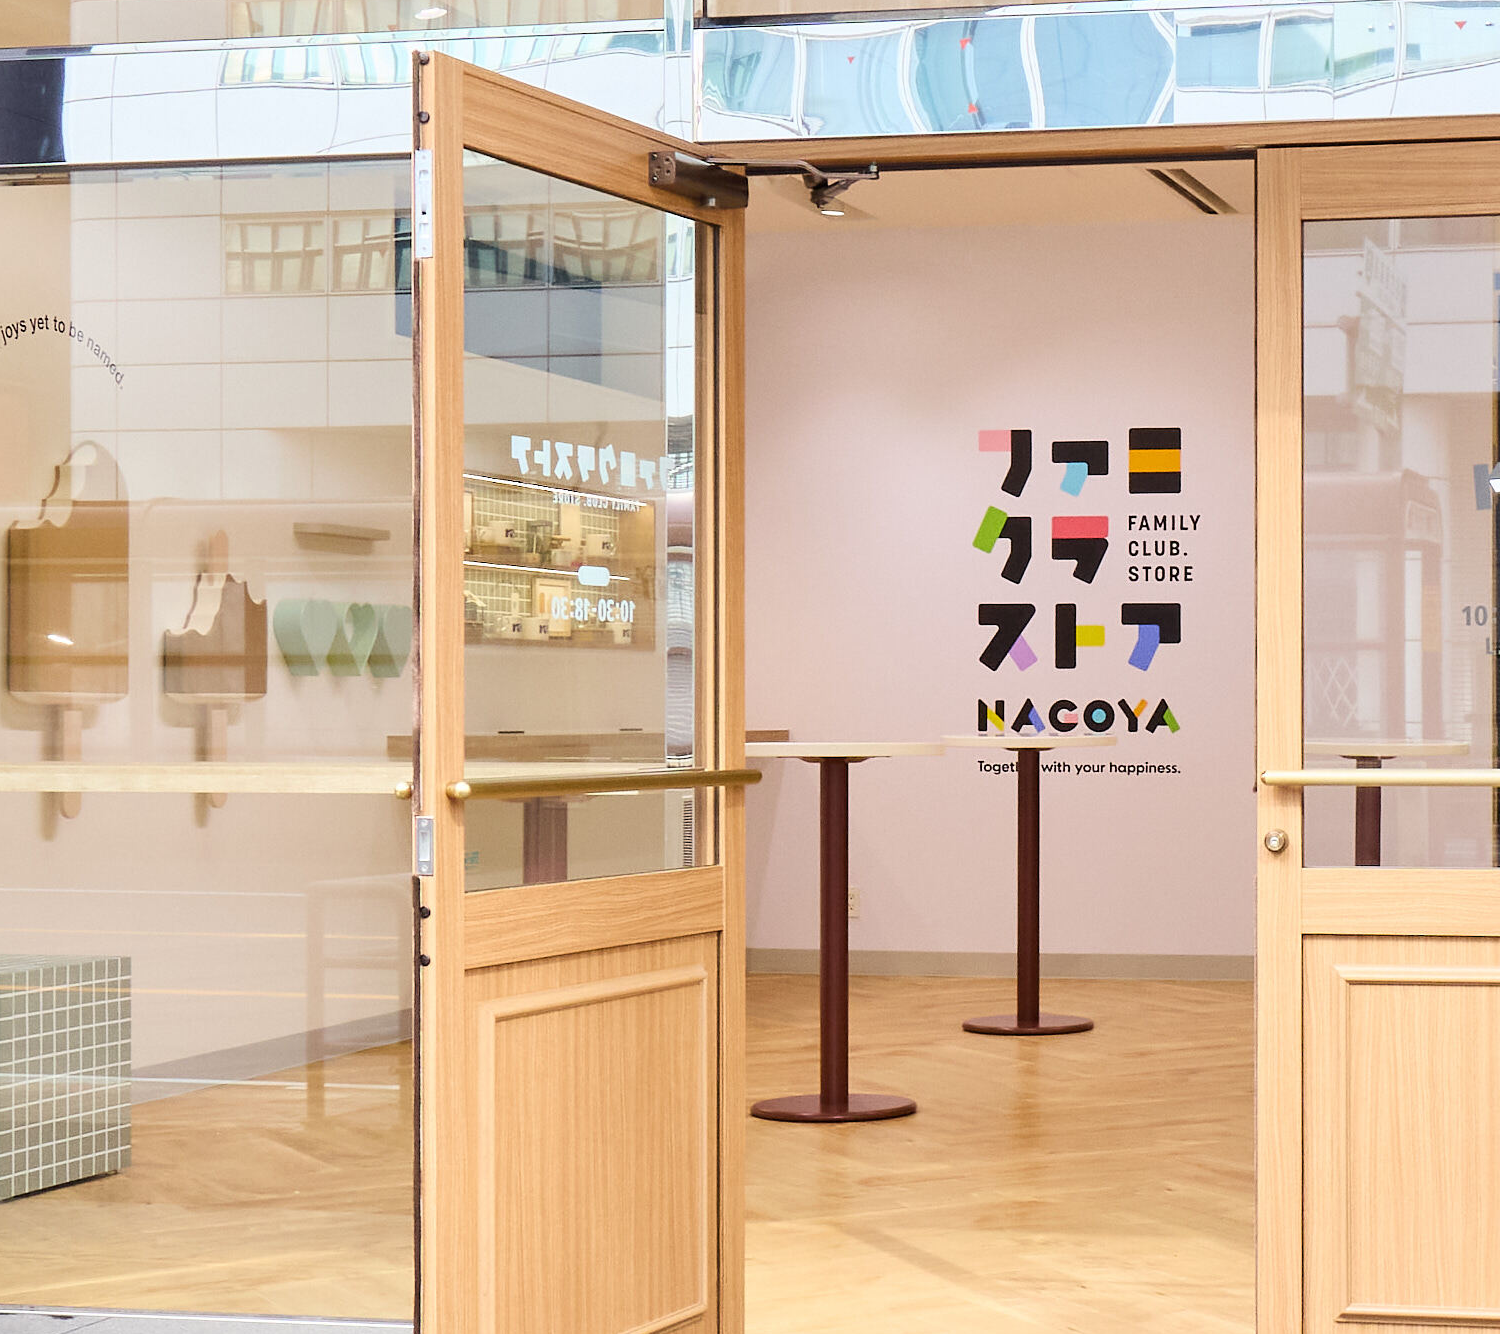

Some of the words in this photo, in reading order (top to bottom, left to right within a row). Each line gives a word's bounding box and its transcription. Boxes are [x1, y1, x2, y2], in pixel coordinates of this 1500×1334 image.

[0, 319, 27, 346] joys
[29, 315, 49, 334] yet
[53, 316, 65, 333] to
[69, 321, 84, 342] be
[86, 337, 125, 389] named.
[1128, 514, 1202, 531] FAMILY
[1128, 540, 1189, 557] CLUB.
[1128, 566, 1194, 582] STORE
[978, 602, 1182, 672] ストア
[977, 697, 1181, 734] NAGOYA
[978, 760, 1019, 775] Toget
[1041, 761, 1071, 774] with
[1075, 764, 1105, 776] your
[1109, 762, 1181, 775] happiness.
